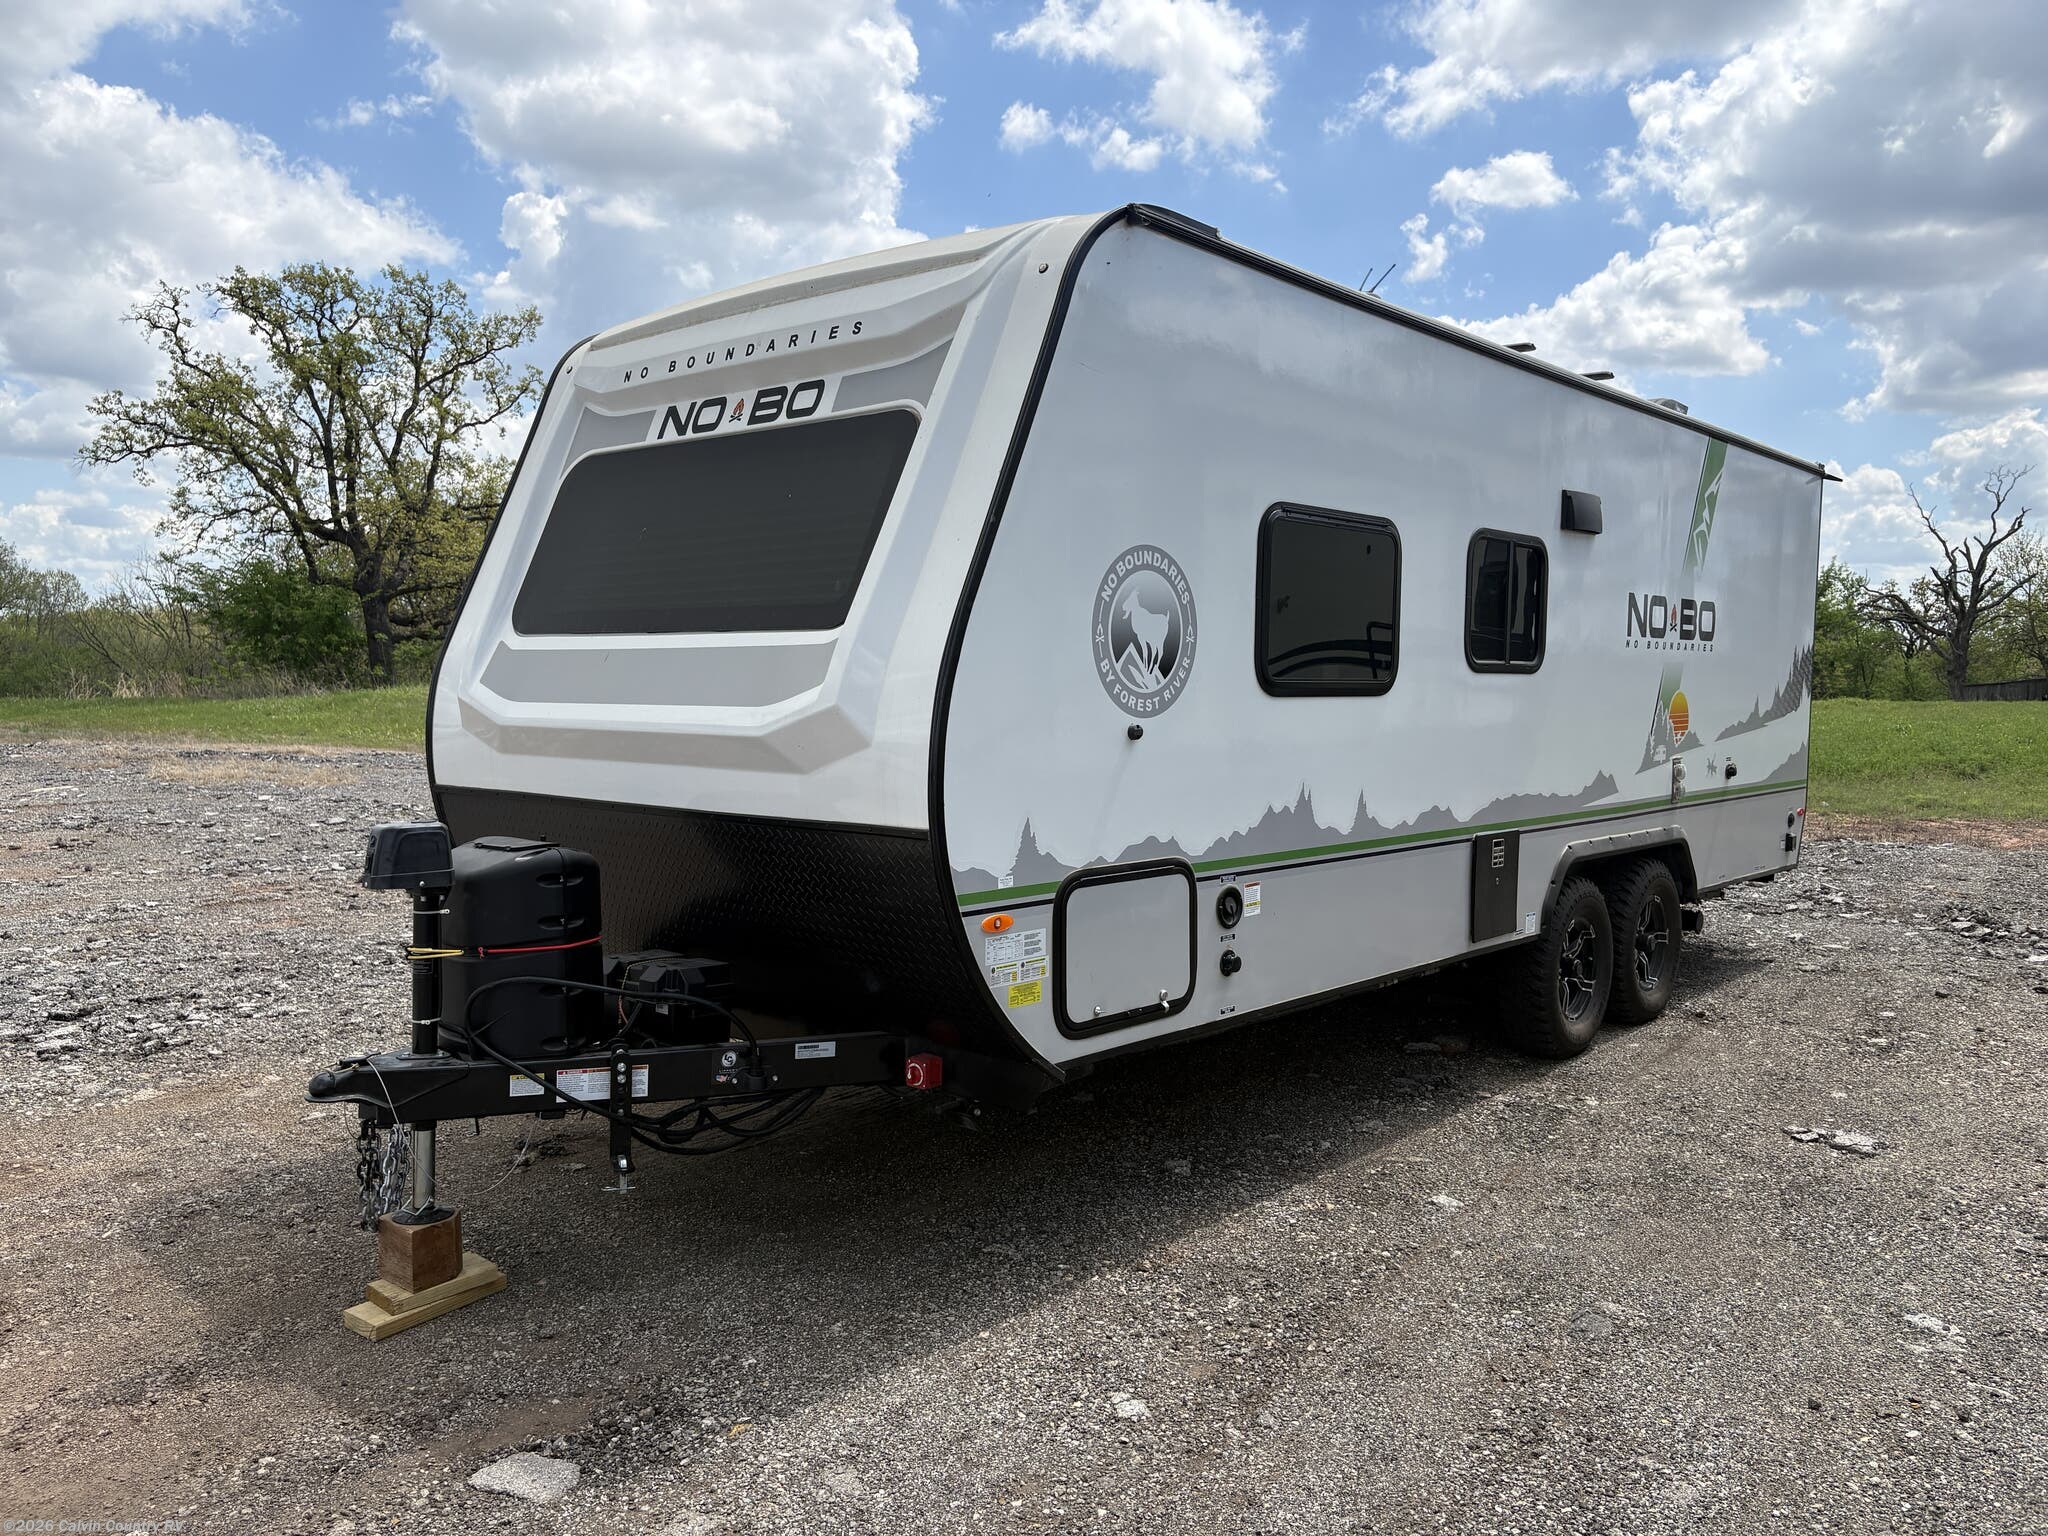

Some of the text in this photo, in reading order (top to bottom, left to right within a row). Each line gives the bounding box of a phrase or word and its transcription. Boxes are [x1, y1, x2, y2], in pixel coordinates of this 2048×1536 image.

[623, 321, 863, 383] NO BOUNDARIES
[1101, 550, 1190, 605] NO BOUNDARIES
[1625, 640, 1713, 652] NO BOUNDARIES
[1100, 658, 1191, 711] BY FOREST RIVER
